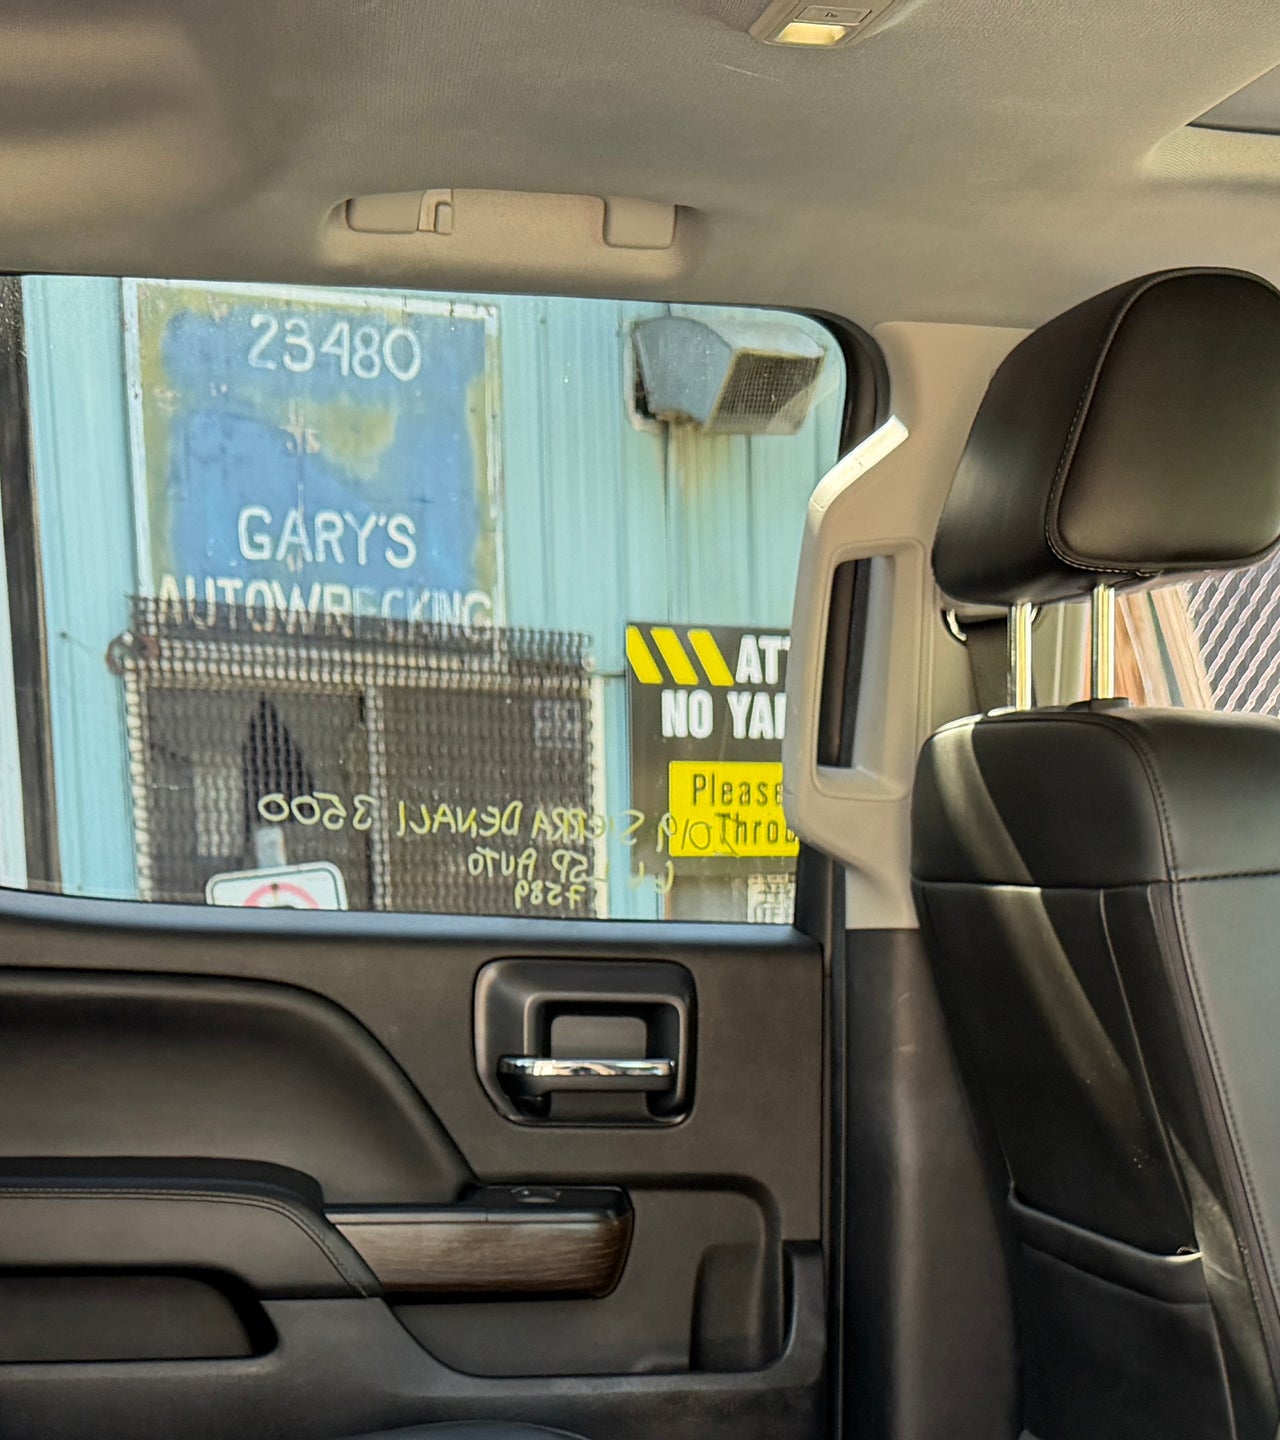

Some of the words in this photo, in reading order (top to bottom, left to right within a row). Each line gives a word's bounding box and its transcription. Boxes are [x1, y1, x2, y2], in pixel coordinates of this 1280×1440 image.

[247, 313, 422, 382] 23480
[237, 505, 418, 570] GARY'S
[661, 688, 714, 739] NO
